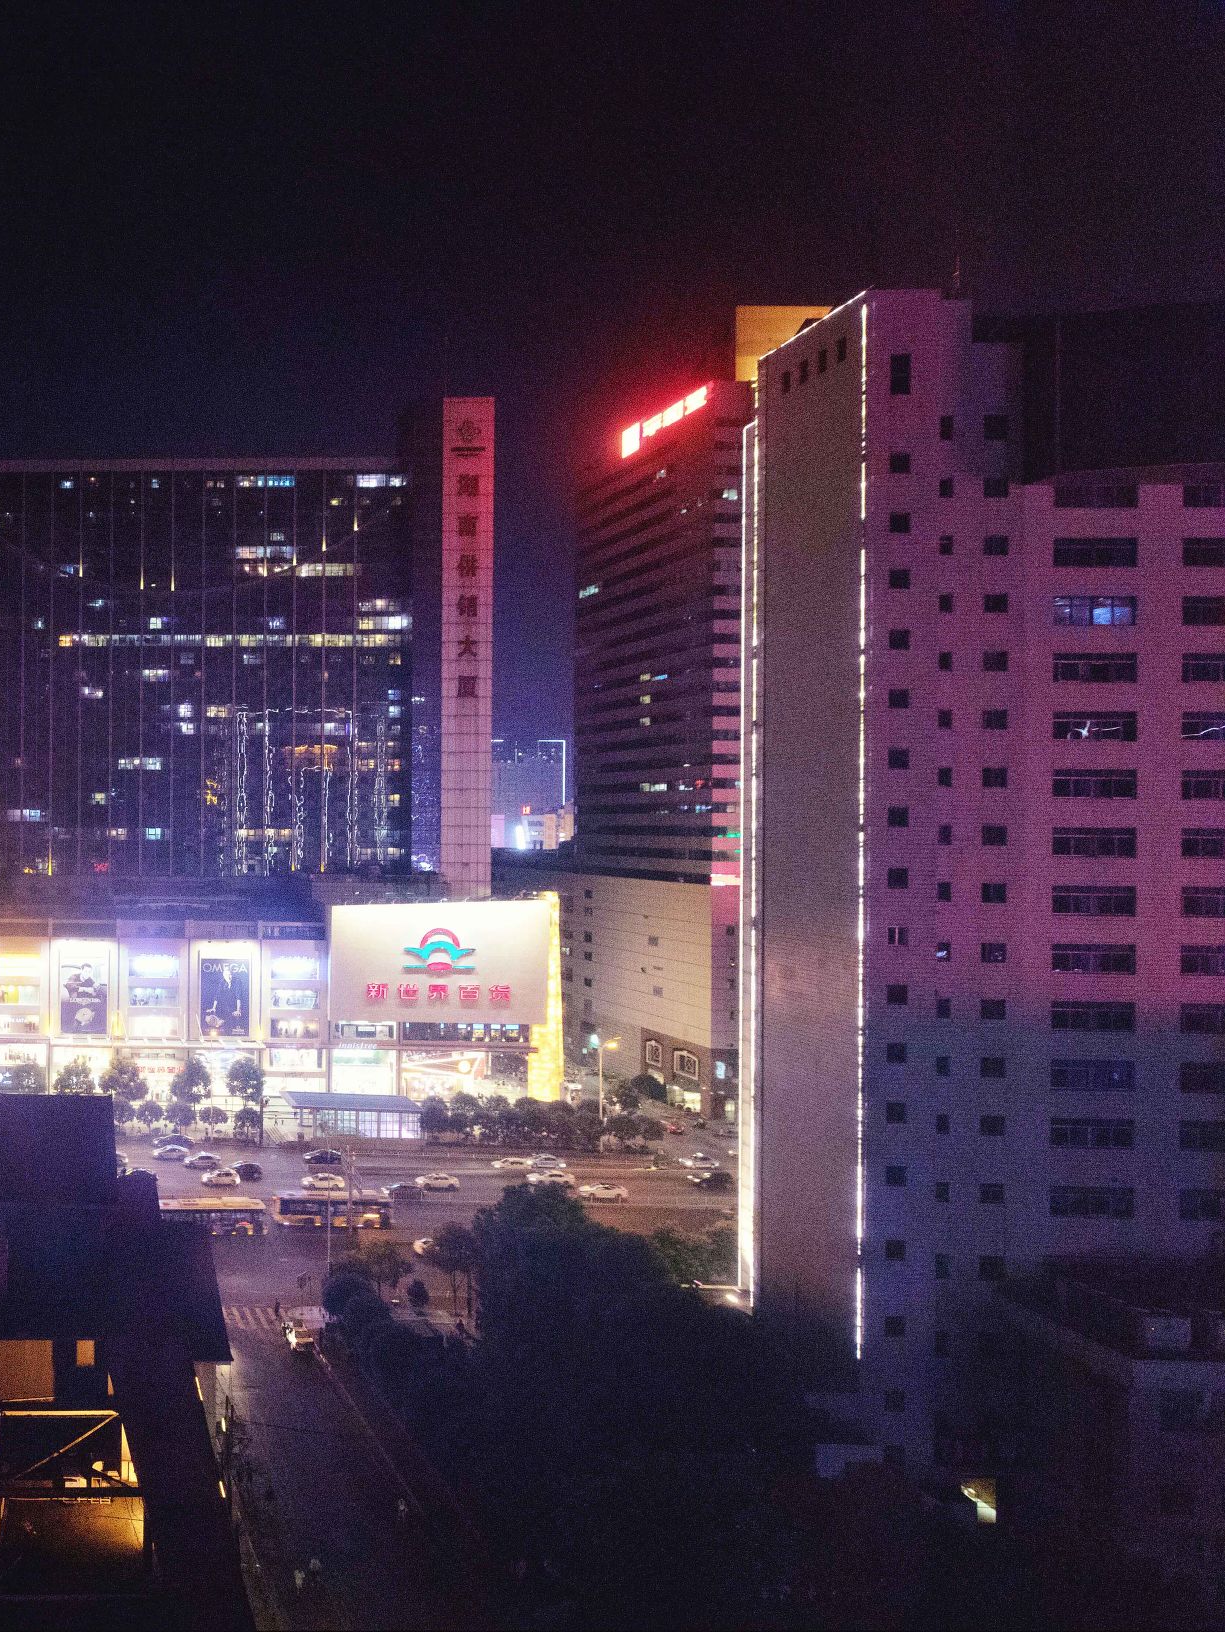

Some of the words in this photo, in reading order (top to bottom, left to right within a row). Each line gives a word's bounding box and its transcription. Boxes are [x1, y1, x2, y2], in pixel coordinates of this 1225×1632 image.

[202, 963, 248, 973] OMEGA
[367, 983, 511, 1001] 新世界百货
